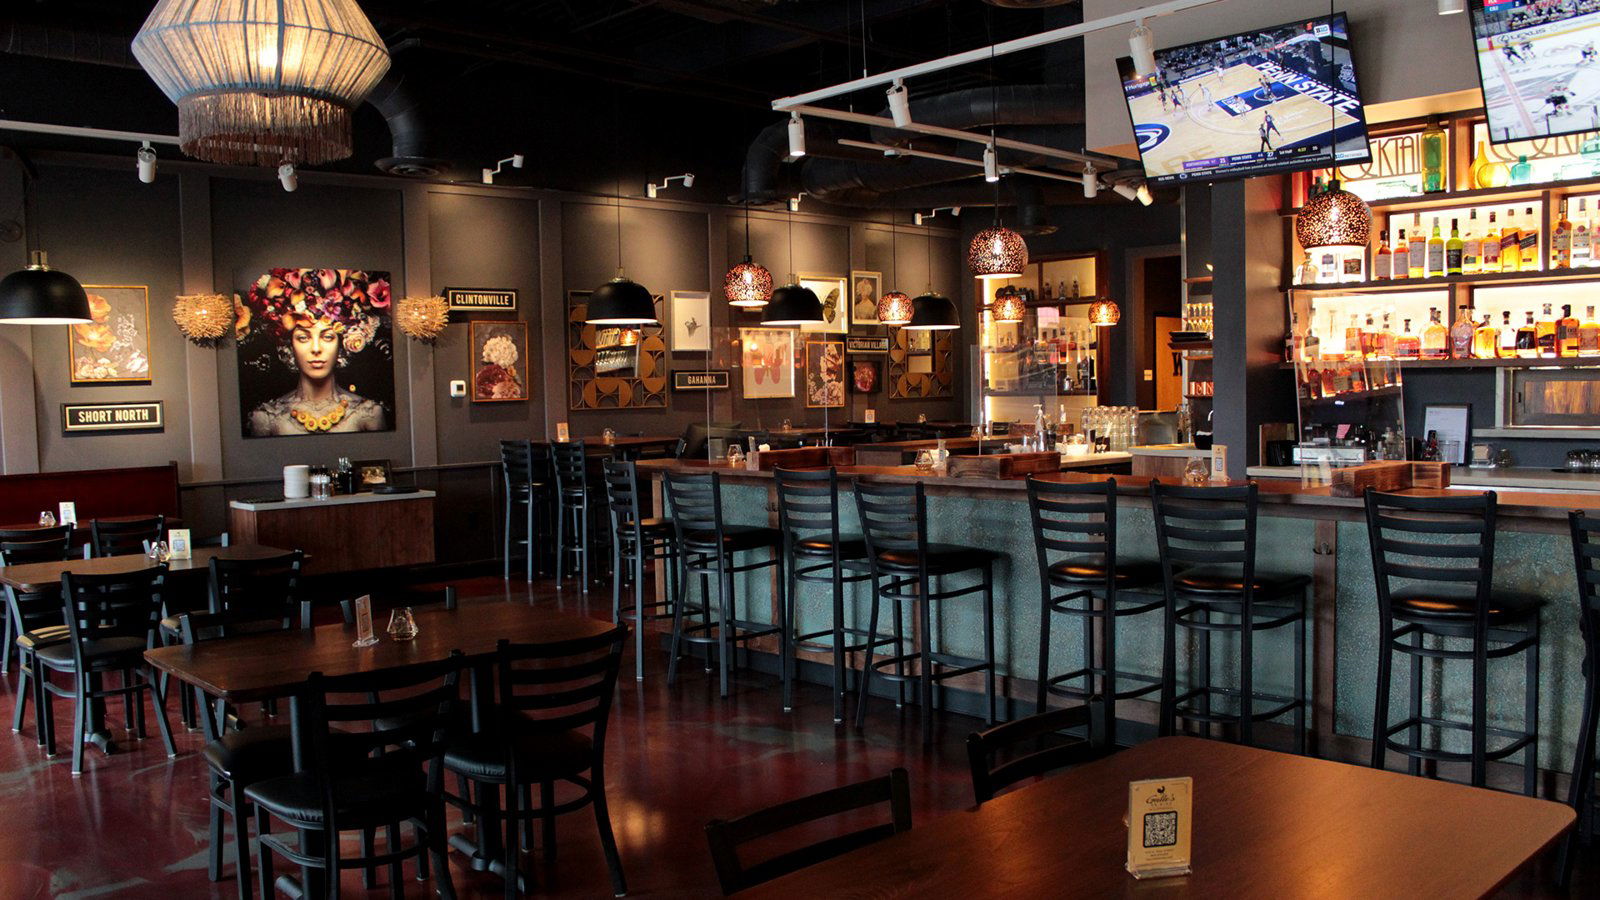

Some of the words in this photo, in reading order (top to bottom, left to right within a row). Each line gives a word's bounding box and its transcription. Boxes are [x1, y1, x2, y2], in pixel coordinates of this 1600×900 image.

[1254, 62, 1304, 85] PENN
[1292, 81, 1360, 113] STATE
[456, 293, 510, 306] CLINTONVILLE
[687, 375, 717, 385] GAHANNA
[78, 410, 113, 423] SHORT
[115, 408, 149, 422] NORTH
